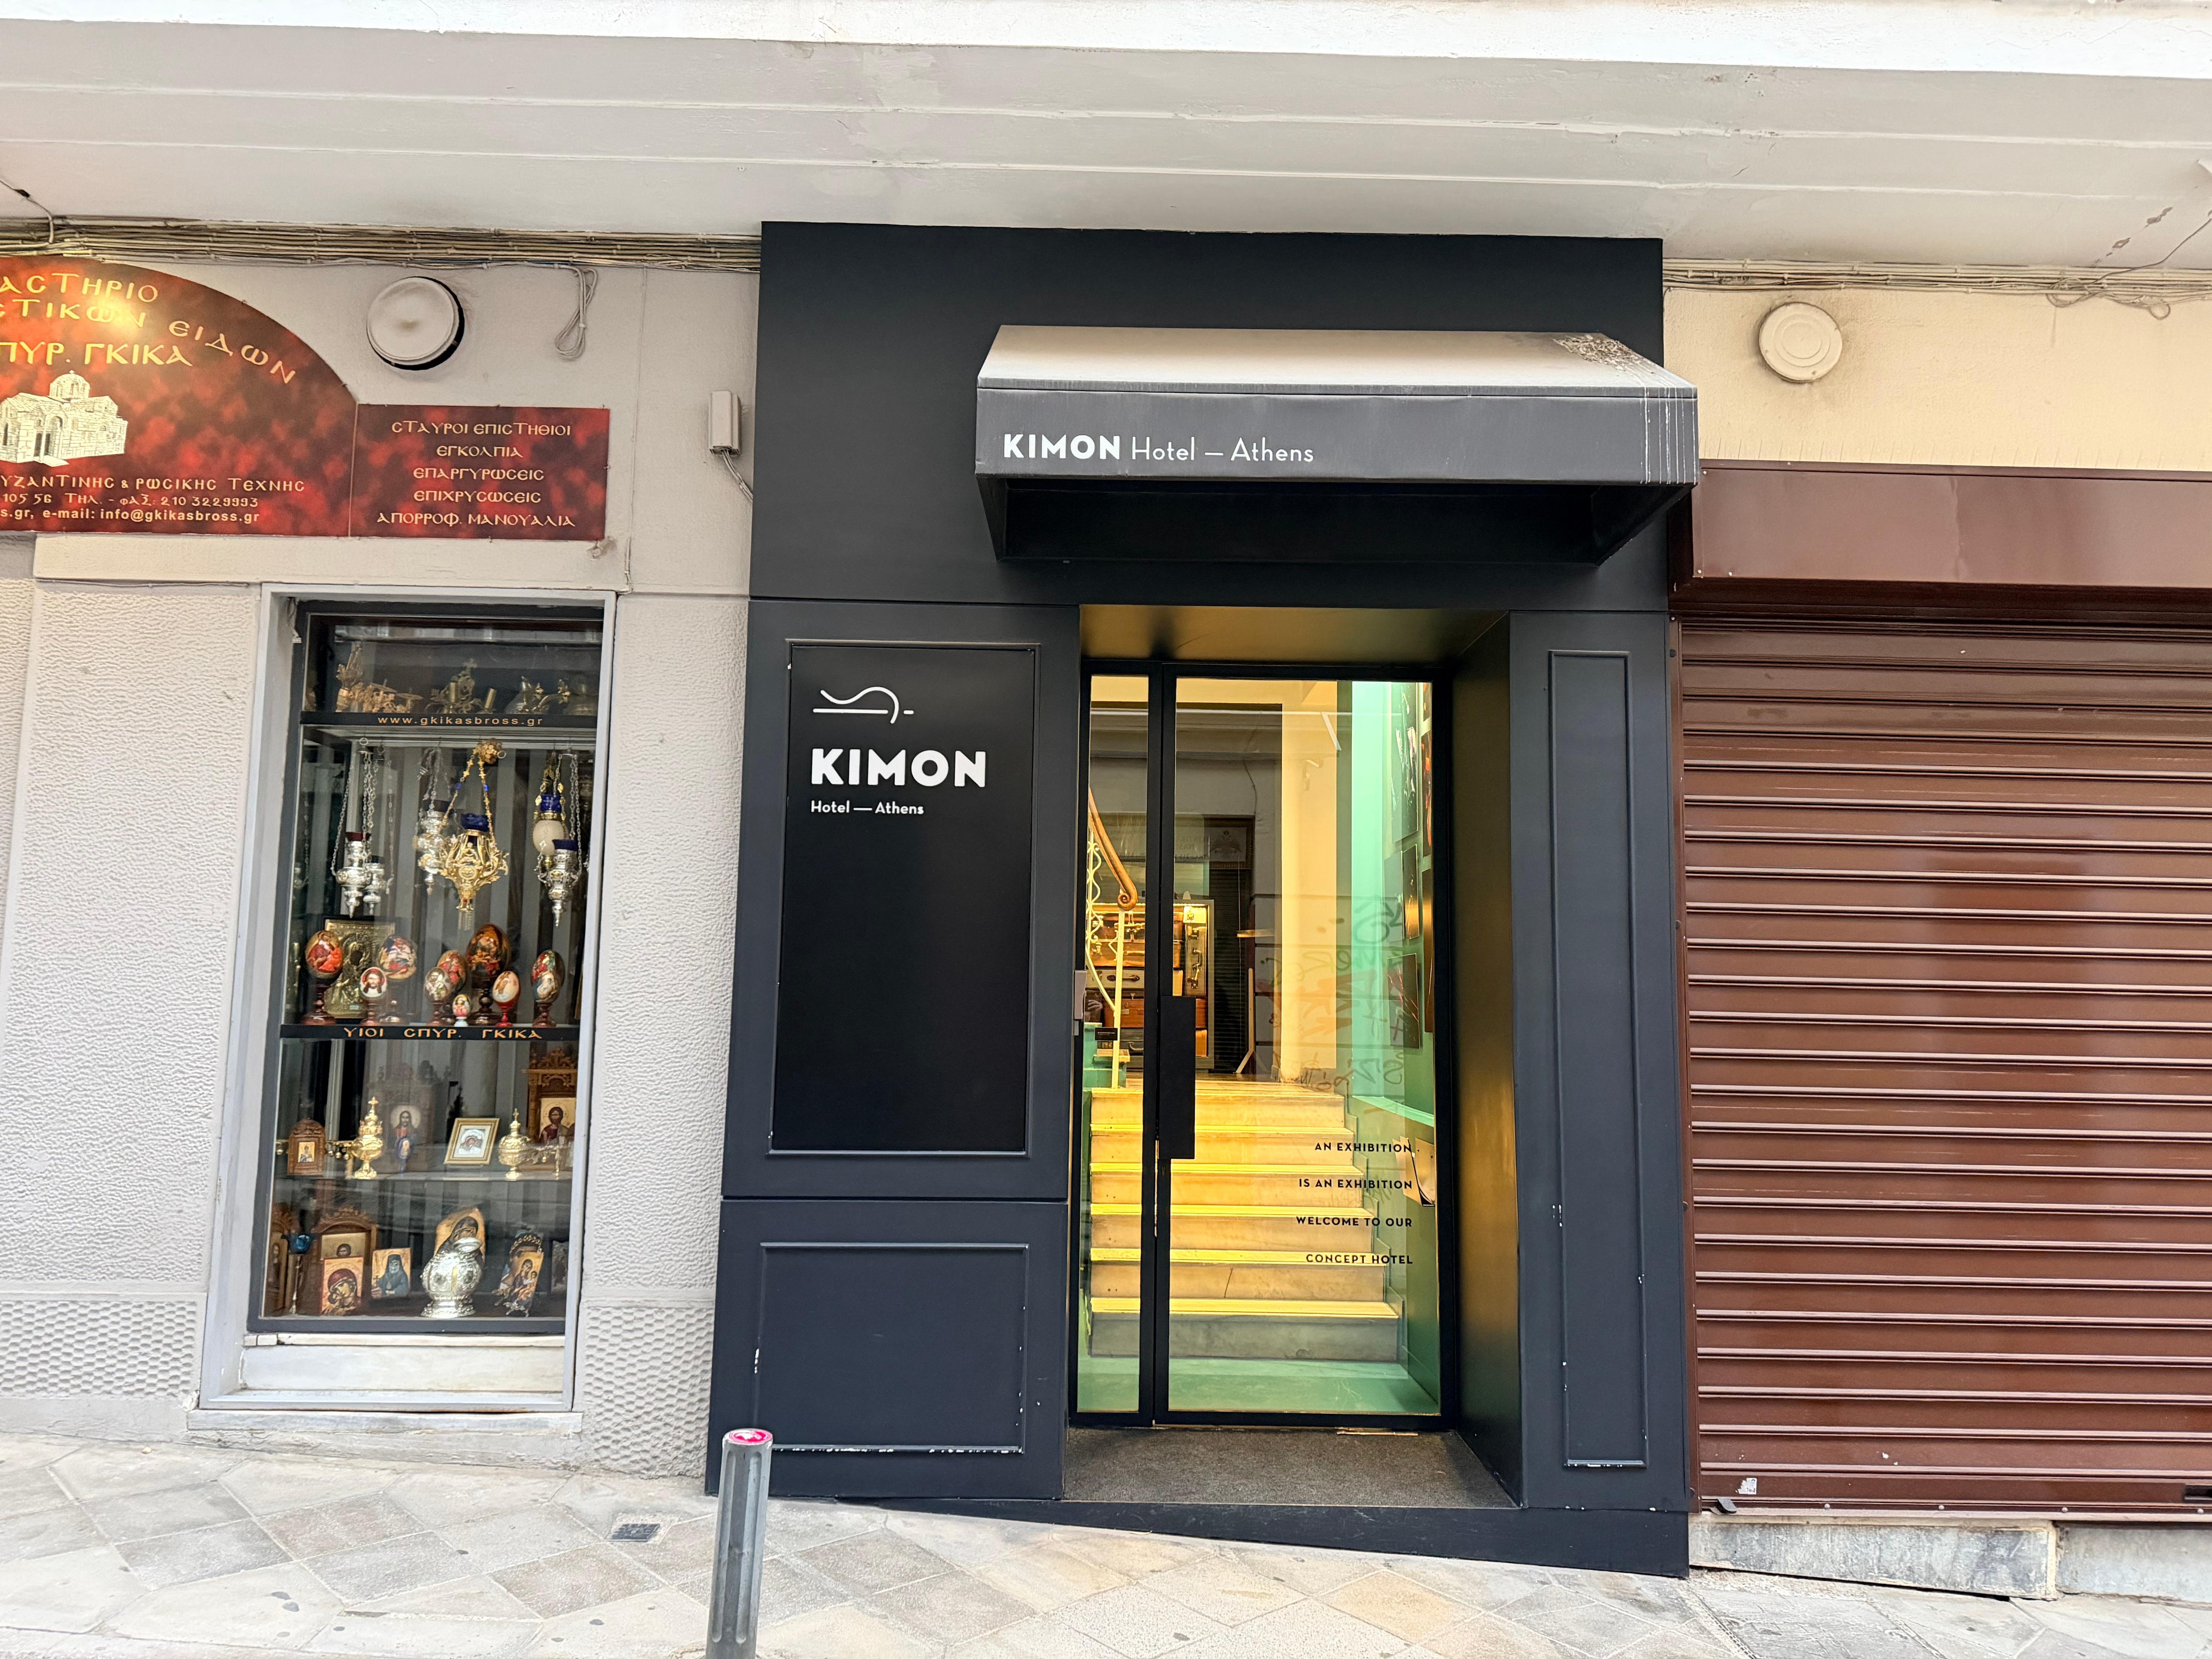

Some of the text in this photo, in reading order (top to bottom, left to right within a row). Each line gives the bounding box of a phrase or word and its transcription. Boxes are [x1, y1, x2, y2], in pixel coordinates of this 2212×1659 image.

[84, 343, 193, 366] ΓΚΙΚΑ
[1003, 434, 1120, 460] KIMON
[1131, 436, 1194, 461] Hotel
[1231, 437, 1314, 462] Athens
[121, 480, 129, 488] &
[2, 493, 28, 504] 105
[33, 493, 52, 505] 56
[161, 496, 186, 506] 210
[192, 496, 258, 507] 3229993
[43, 508, 95, 519] e-mail:
[100, 508, 260, 524] info@gkikasbross.gr
[377, 715, 543, 726] www.gkikasbross.gr
[811, 748, 986, 787] KIMON
[810, 800, 850, 814] Hotel
[874, 801, 924, 815] Athens
[344, 1027, 384, 1038] ΥΙΟΙ
[482, 1029, 542, 1040] ΓΚΙΚΑ
[1314, 1142, 1412, 1152] AN EXHIBITION
[1299, 1178, 1412, 1189] IS AN EXHIBITION
[1296, 1216, 1412, 1227] WELCOME TO OUR
[1306, 1254, 1413, 1264] CONCEPT HOTEL
